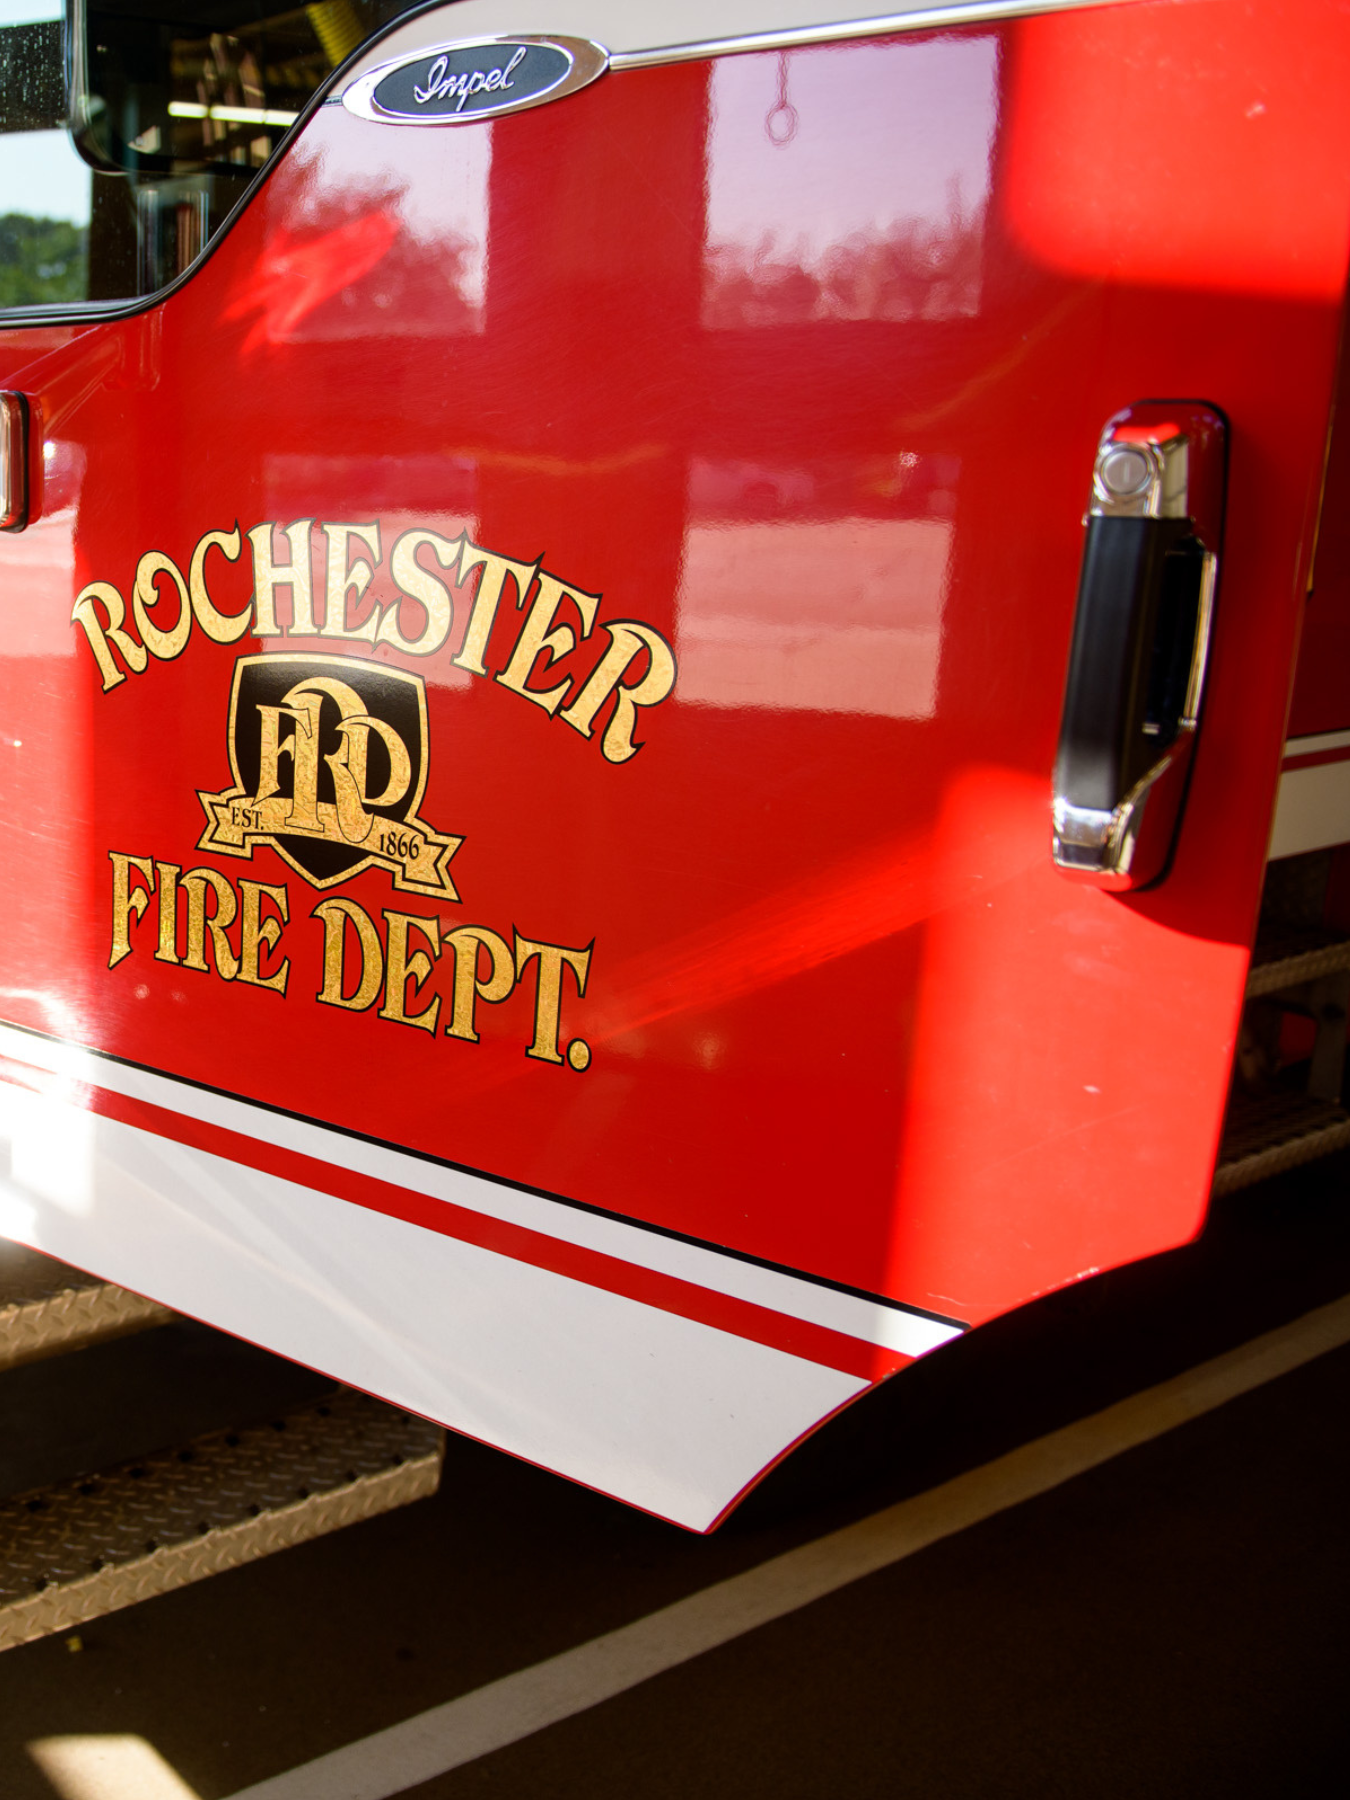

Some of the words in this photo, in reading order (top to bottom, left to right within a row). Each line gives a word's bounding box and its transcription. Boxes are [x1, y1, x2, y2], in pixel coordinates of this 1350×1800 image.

[413, 46, 527, 113] Impel
[71, 517, 677, 764] ROCHESTER
[231, 806, 264, 831] EST.
[378, 831, 420, 860] 1866
[108, 851, 291, 998] FIRE
[310, 897, 596, 1073] DEPT.
